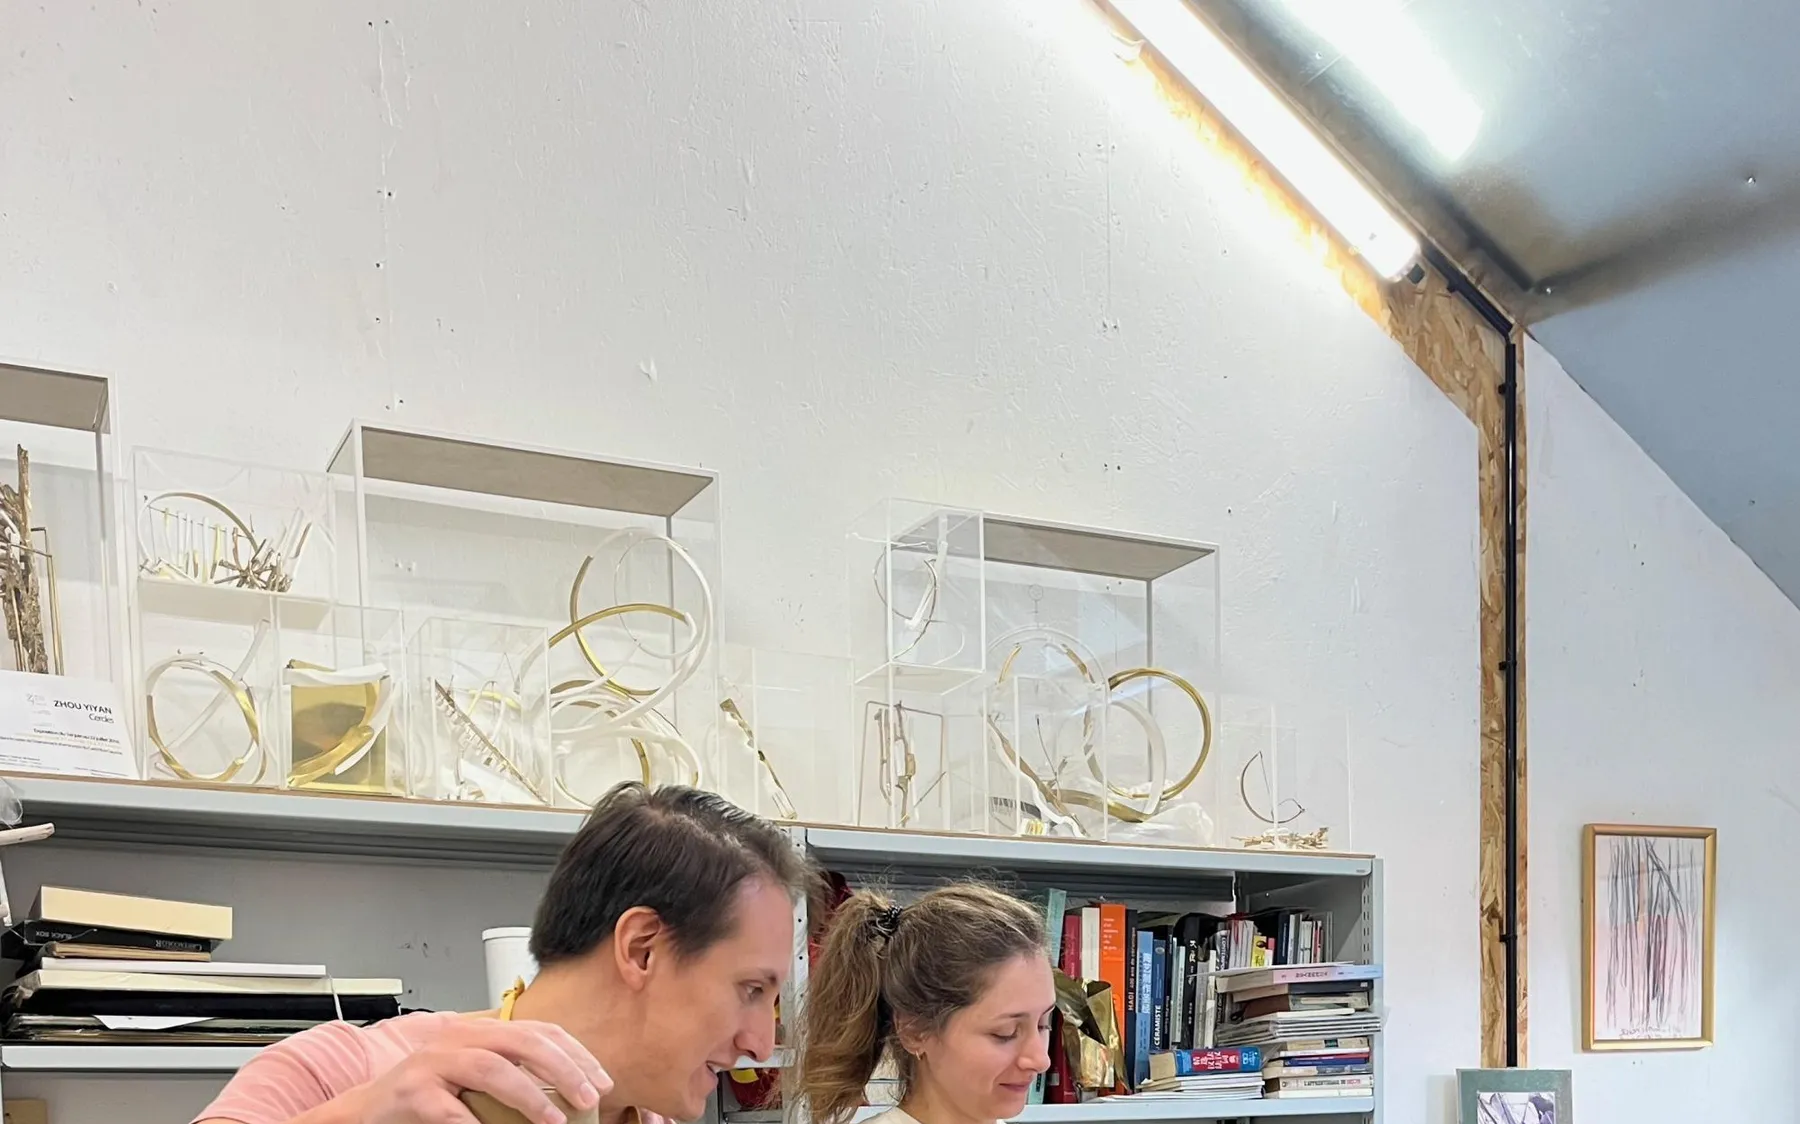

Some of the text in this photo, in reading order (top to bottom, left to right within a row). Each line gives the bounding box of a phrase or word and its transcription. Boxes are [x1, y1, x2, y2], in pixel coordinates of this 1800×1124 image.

[53, 700, 82, 710] ZHOU
[83, 704, 112, 714] YIYAN
[1153, 1005, 1162, 1046] CÉRAMISTE
